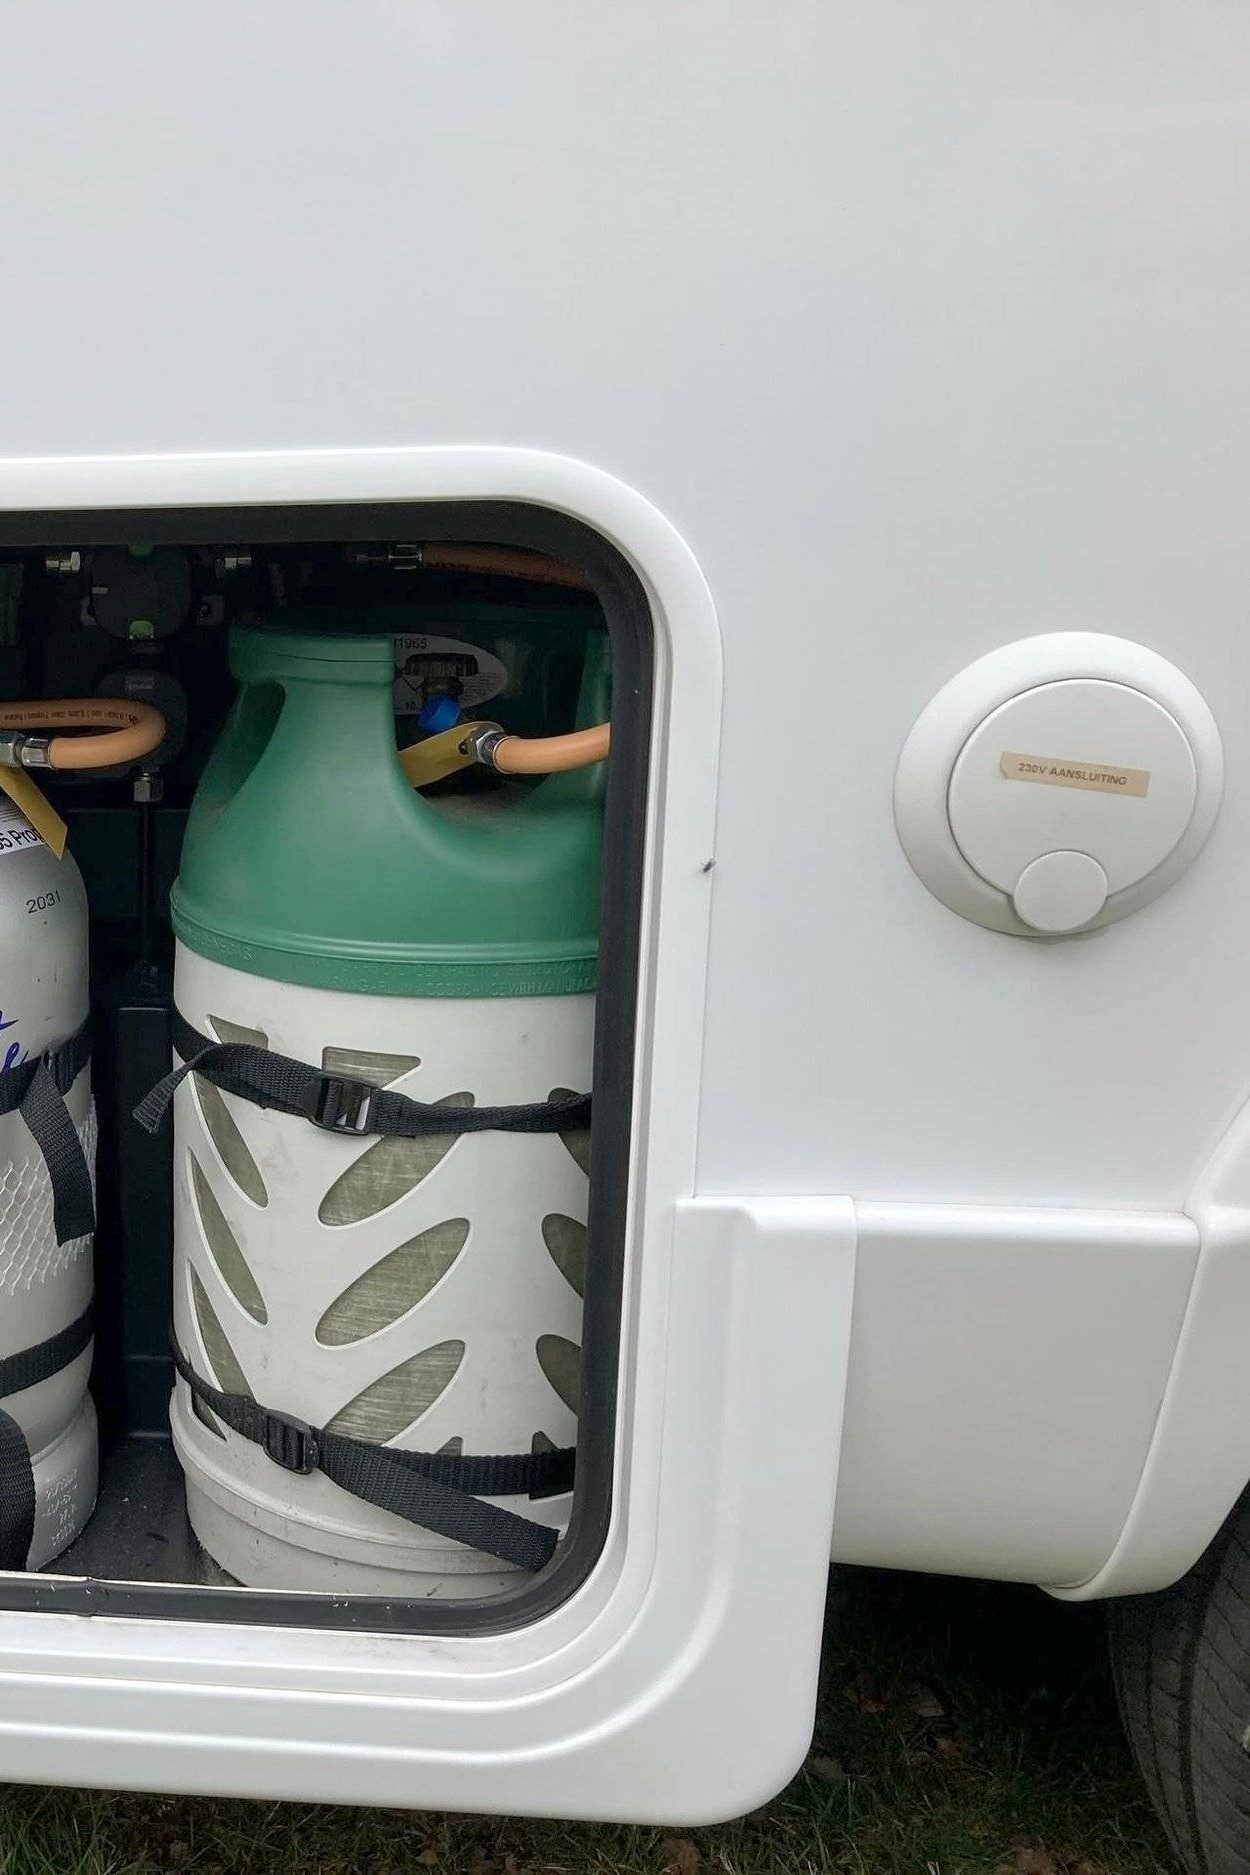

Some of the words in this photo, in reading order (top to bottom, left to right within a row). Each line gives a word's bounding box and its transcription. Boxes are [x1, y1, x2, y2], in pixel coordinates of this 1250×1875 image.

[395, 638, 427, 649] 1965
[1018, 762, 1048, 774] 230V
[1049, 768, 1128, 786] AANSLUITING
[26, 890, 61, 914] 2031
